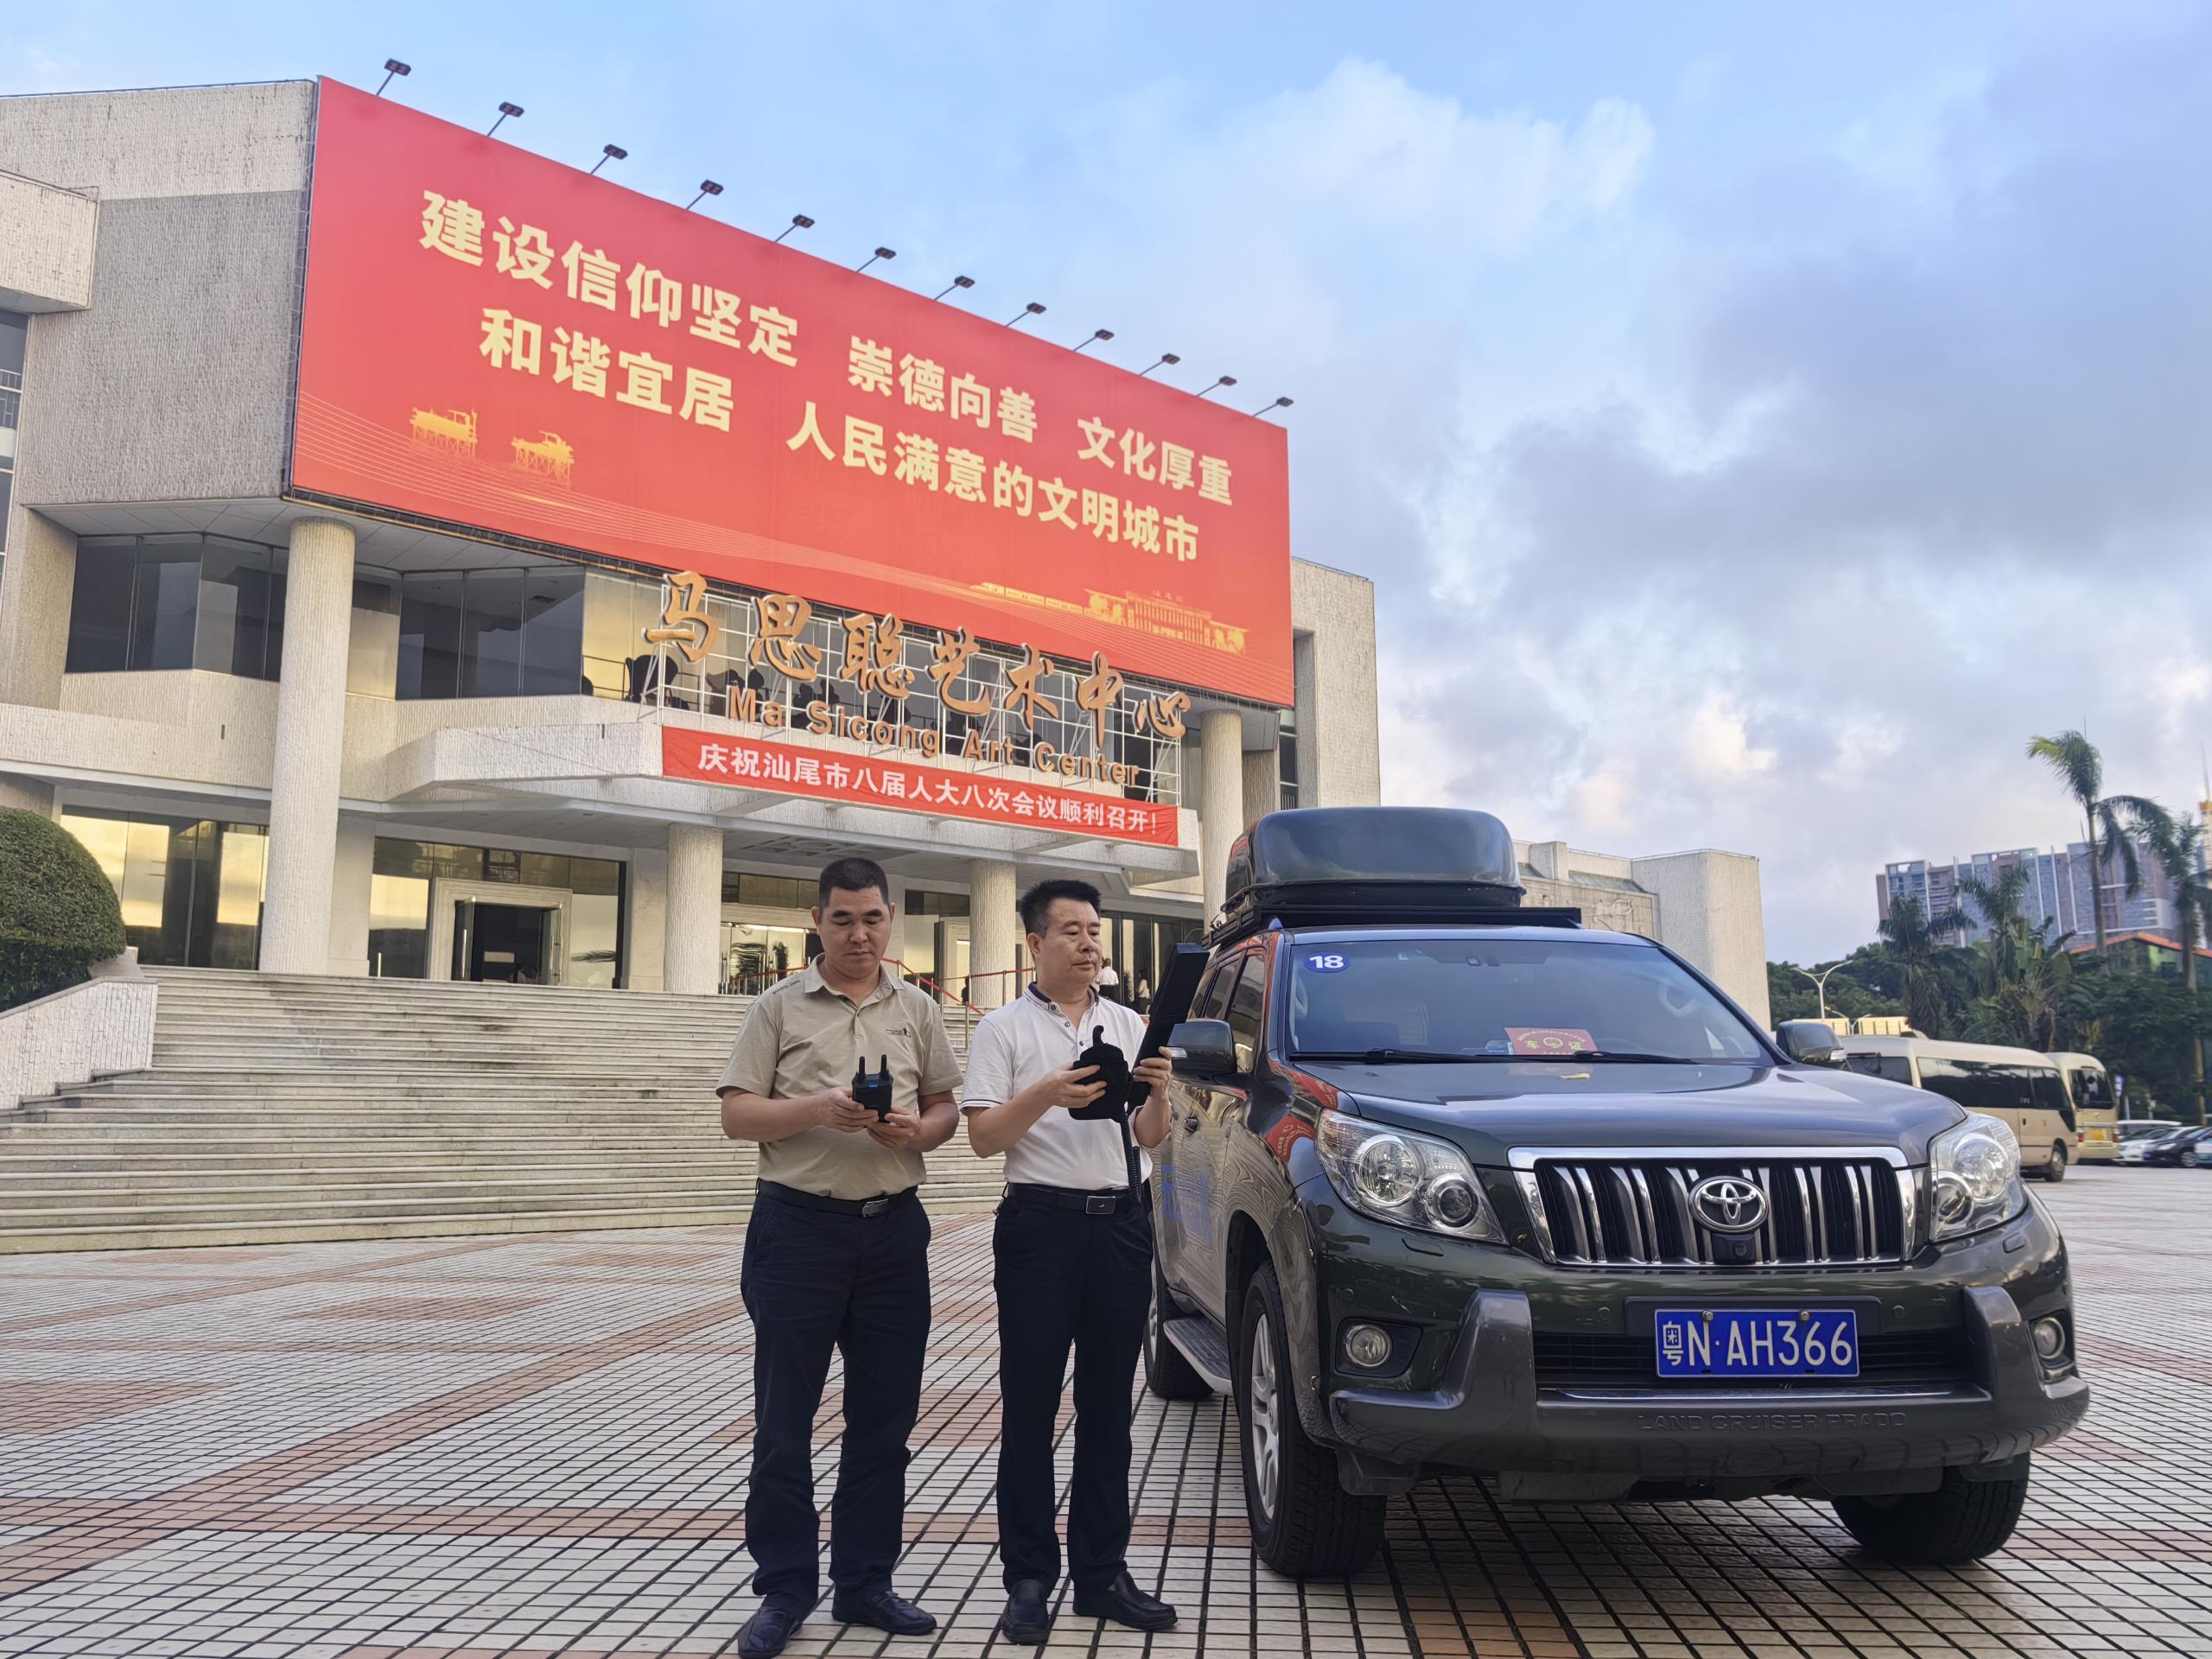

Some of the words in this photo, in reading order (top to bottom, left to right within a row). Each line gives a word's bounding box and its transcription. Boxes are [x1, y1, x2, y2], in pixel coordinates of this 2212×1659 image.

[420, 190, 798, 367] 建设信仰坚定
[849, 335, 1038, 443] 崇德向善
[1077, 416, 1233, 506] 文化厚重
[480, 308, 734, 432] 和谐宜居
[786, 401, 1199, 562] 人民满意的文明城市
[641, 570, 1192, 748] 马思聪艺术中心
[726, 683, 783, 728] Ma
[806, 700, 939, 758] Sicong
[963, 728, 1014, 765] Art
[1034, 741, 1140, 787] Center
[1309, 955, 1344, 969] 18
[1638, 1414, 1703, 1432] LAND
[1711, 1414, 1818, 1432] CRUISER
[1825, 1412, 1907, 1429] PRADO
